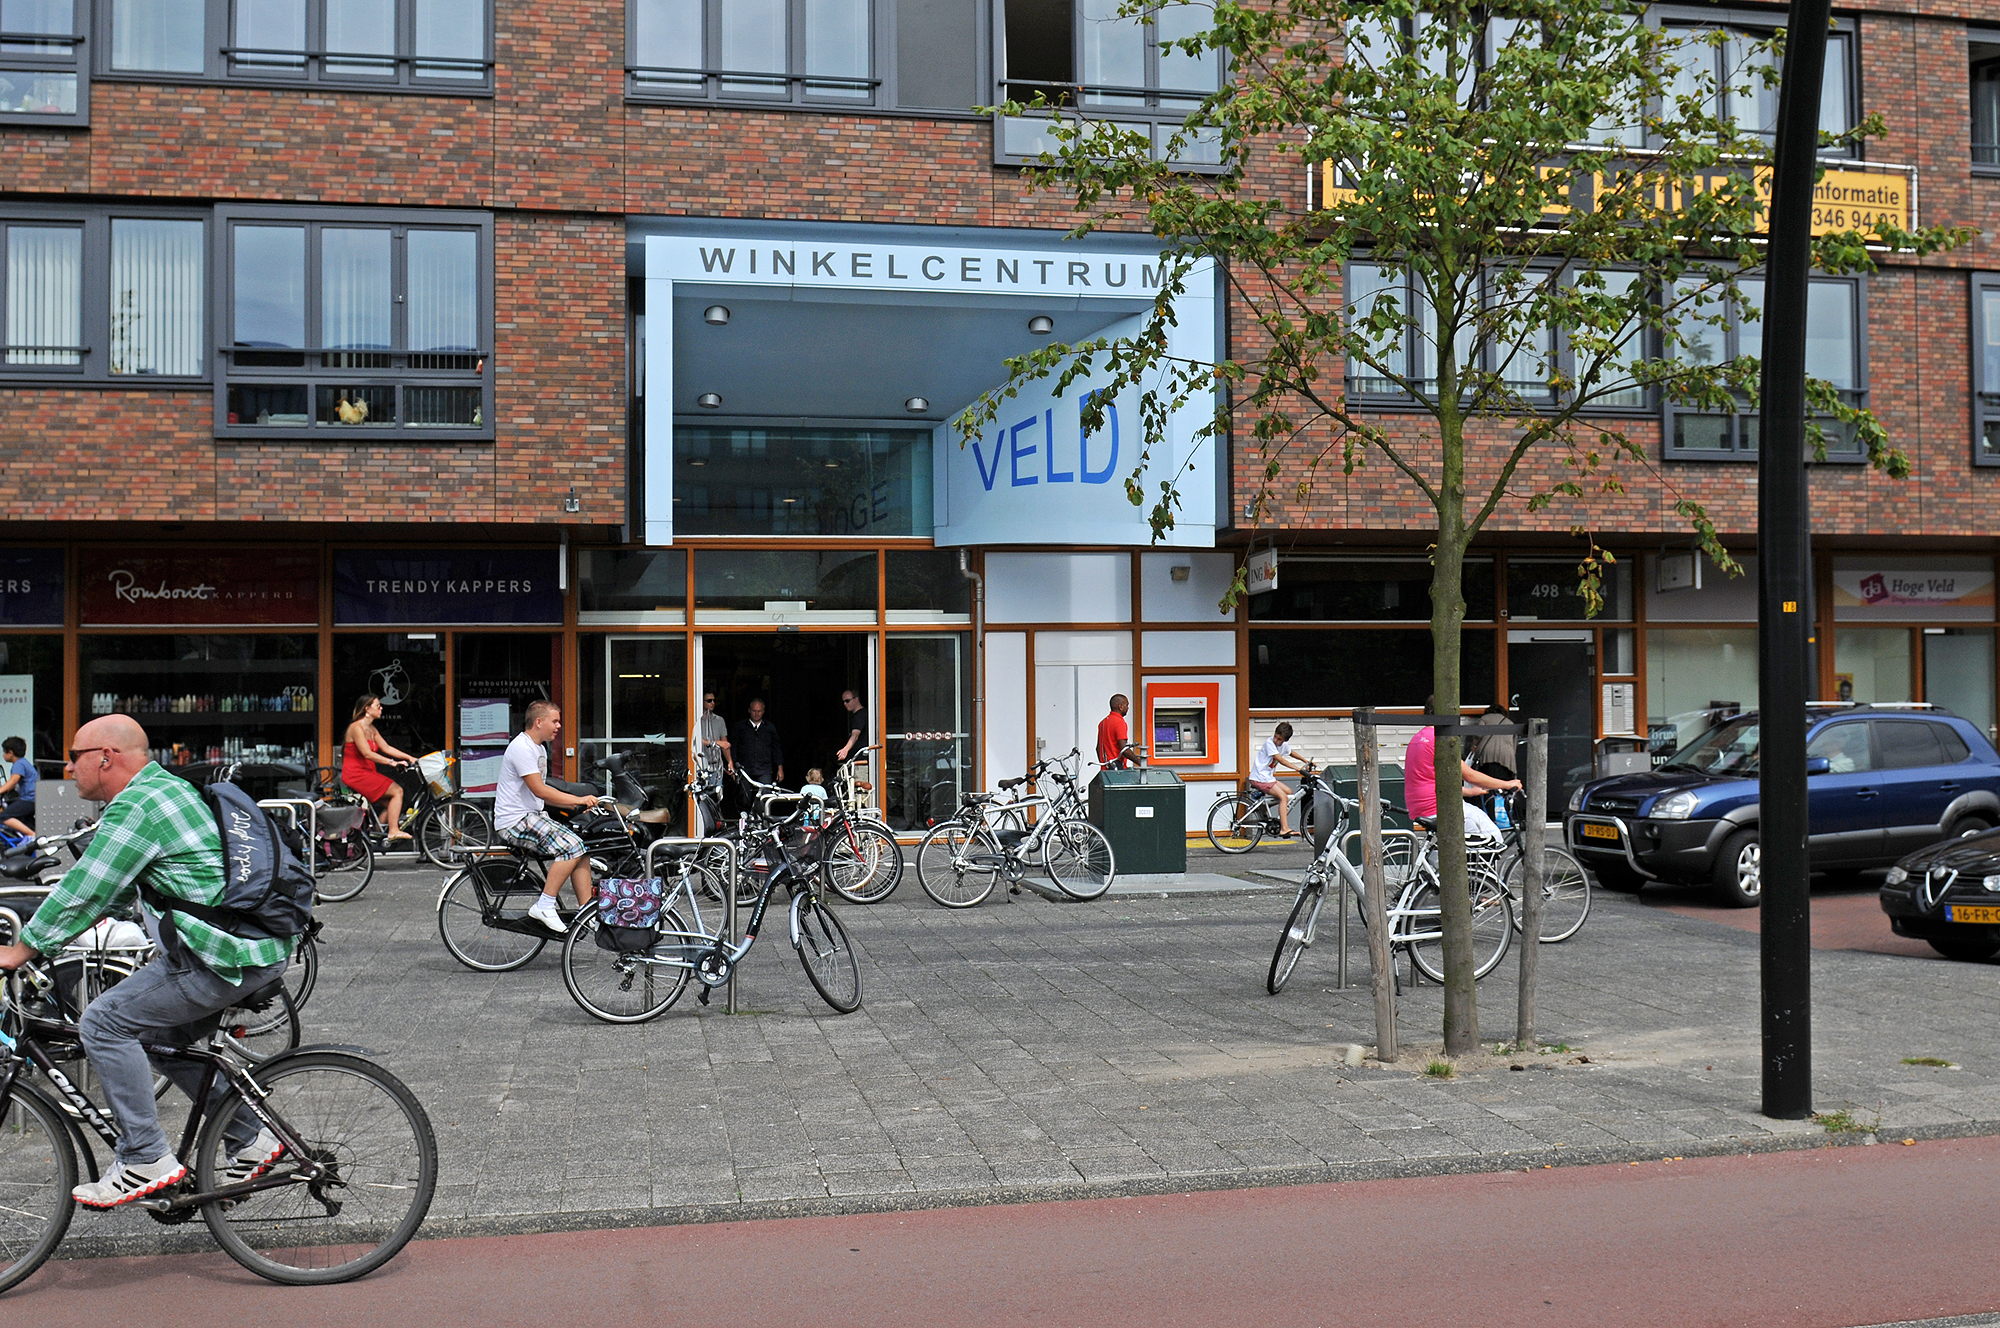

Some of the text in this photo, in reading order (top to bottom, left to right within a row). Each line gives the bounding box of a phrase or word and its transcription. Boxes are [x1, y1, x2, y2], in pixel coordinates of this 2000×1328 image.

[1814, 181, 1900, 205] nformatie
[1813, 208, 1845, 228] 346
[699, 246, 1168, 289] WINKELCENTRUM
[972, 387, 1119, 491] VELD
[1250, 566, 1264, 584] ING
[108, 569, 293, 604] Rombout KAPPERS
[366, 580, 532, 593] TRENDY KAPPERS
[1531, 584, 1559, 597] 498
[1892, 579, 1924, 596] Hoge
[1927, 578, 1955, 592] Veld
[282, 686, 308, 697] 470
[48, 1068, 119, 1139] GIANT
